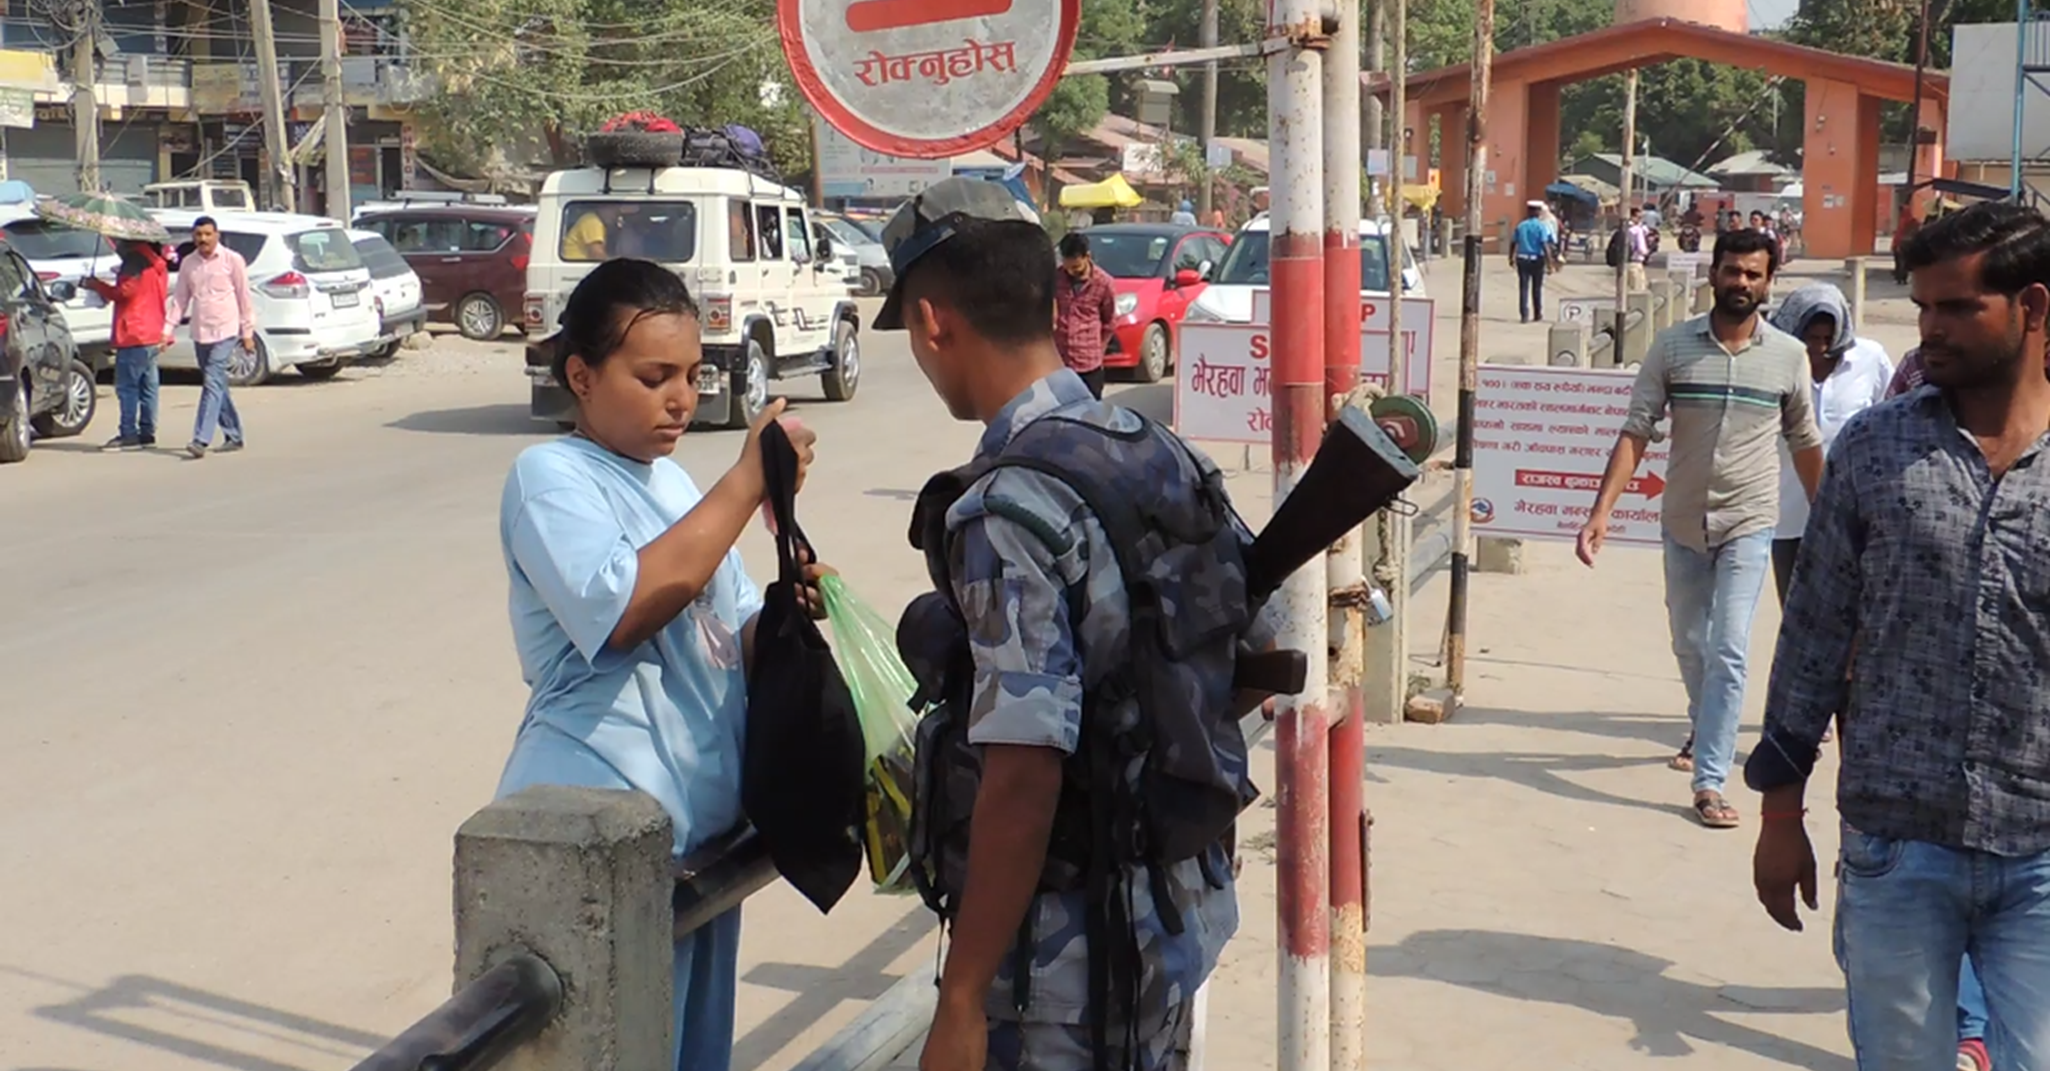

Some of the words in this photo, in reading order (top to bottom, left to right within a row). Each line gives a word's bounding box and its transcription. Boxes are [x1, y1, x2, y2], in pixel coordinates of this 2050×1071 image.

[853, 39, 1018, 86] रोक्नुहोस्
[1191, 353, 1246, 398] भैरहवा
[1611, 508, 1660, 523] कार्याल
